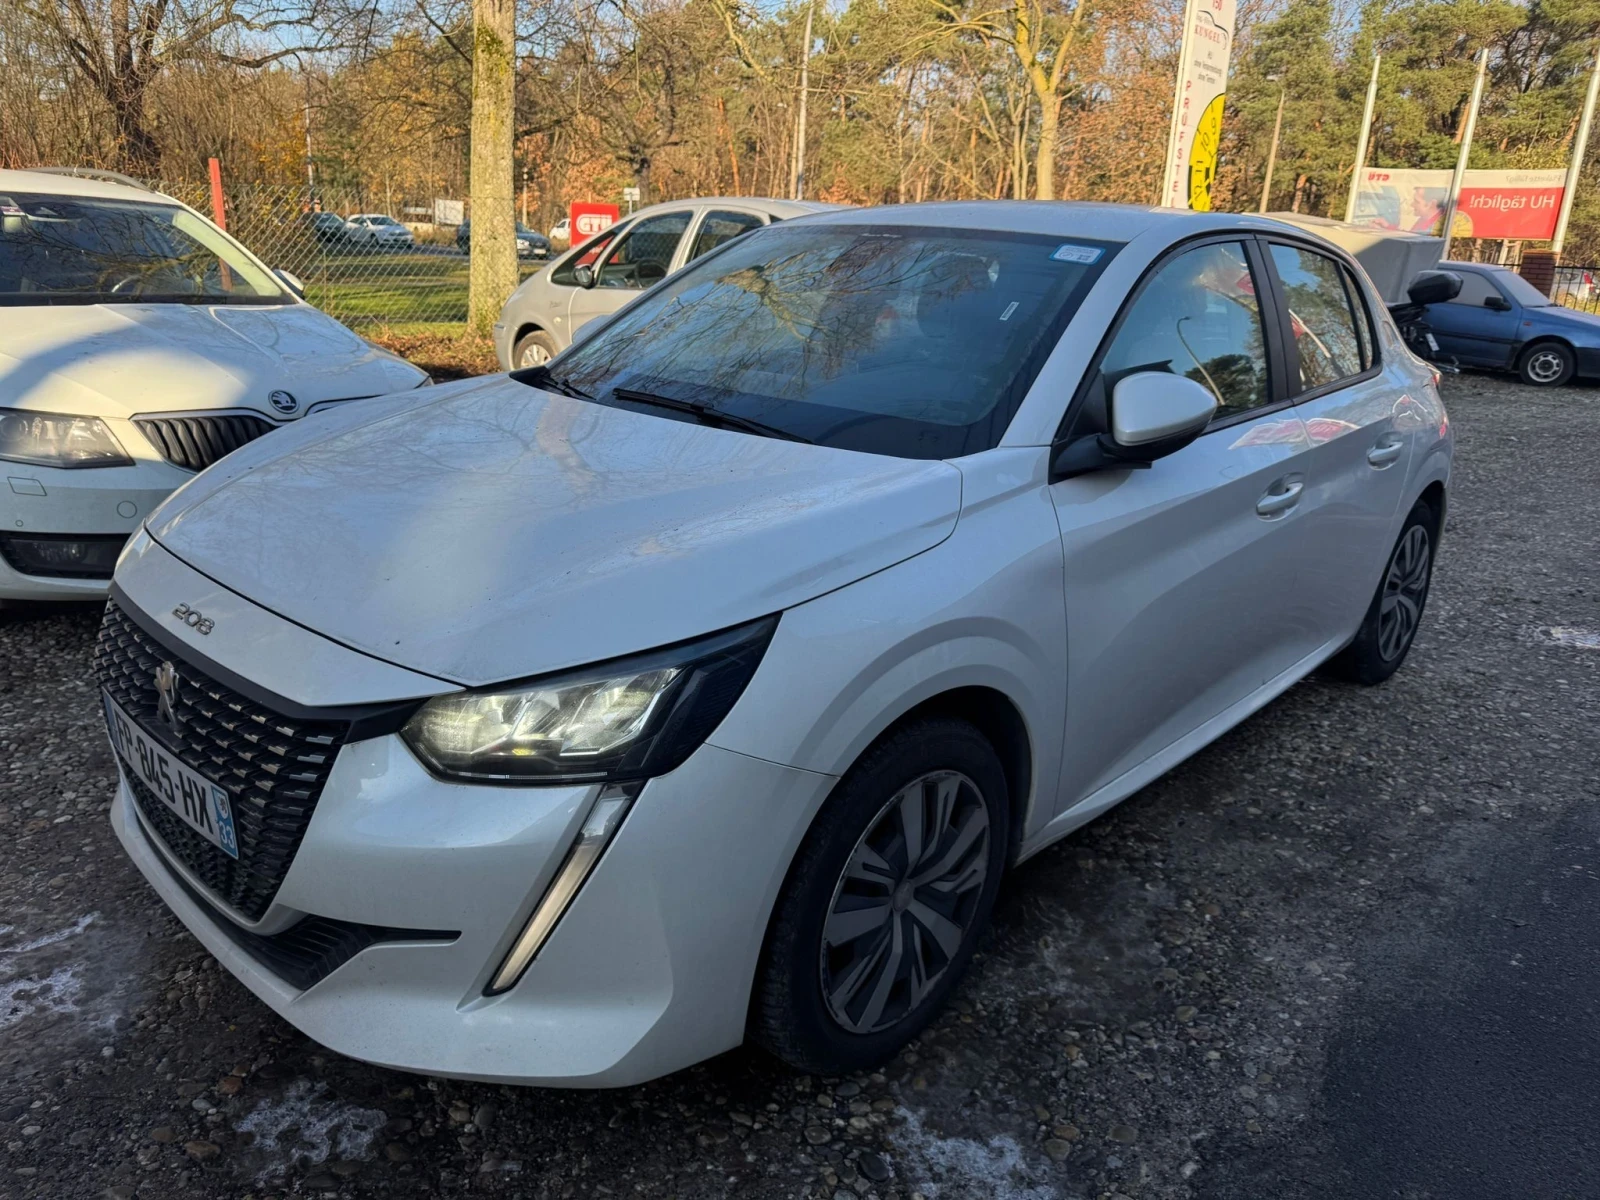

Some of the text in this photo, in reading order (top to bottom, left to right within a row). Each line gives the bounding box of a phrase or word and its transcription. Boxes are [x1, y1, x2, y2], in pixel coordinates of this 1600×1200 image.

[172, 602, 216, 635] 208
[114, 708, 214, 835] FP-845-HX
[218, 820, 236, 850] 33
